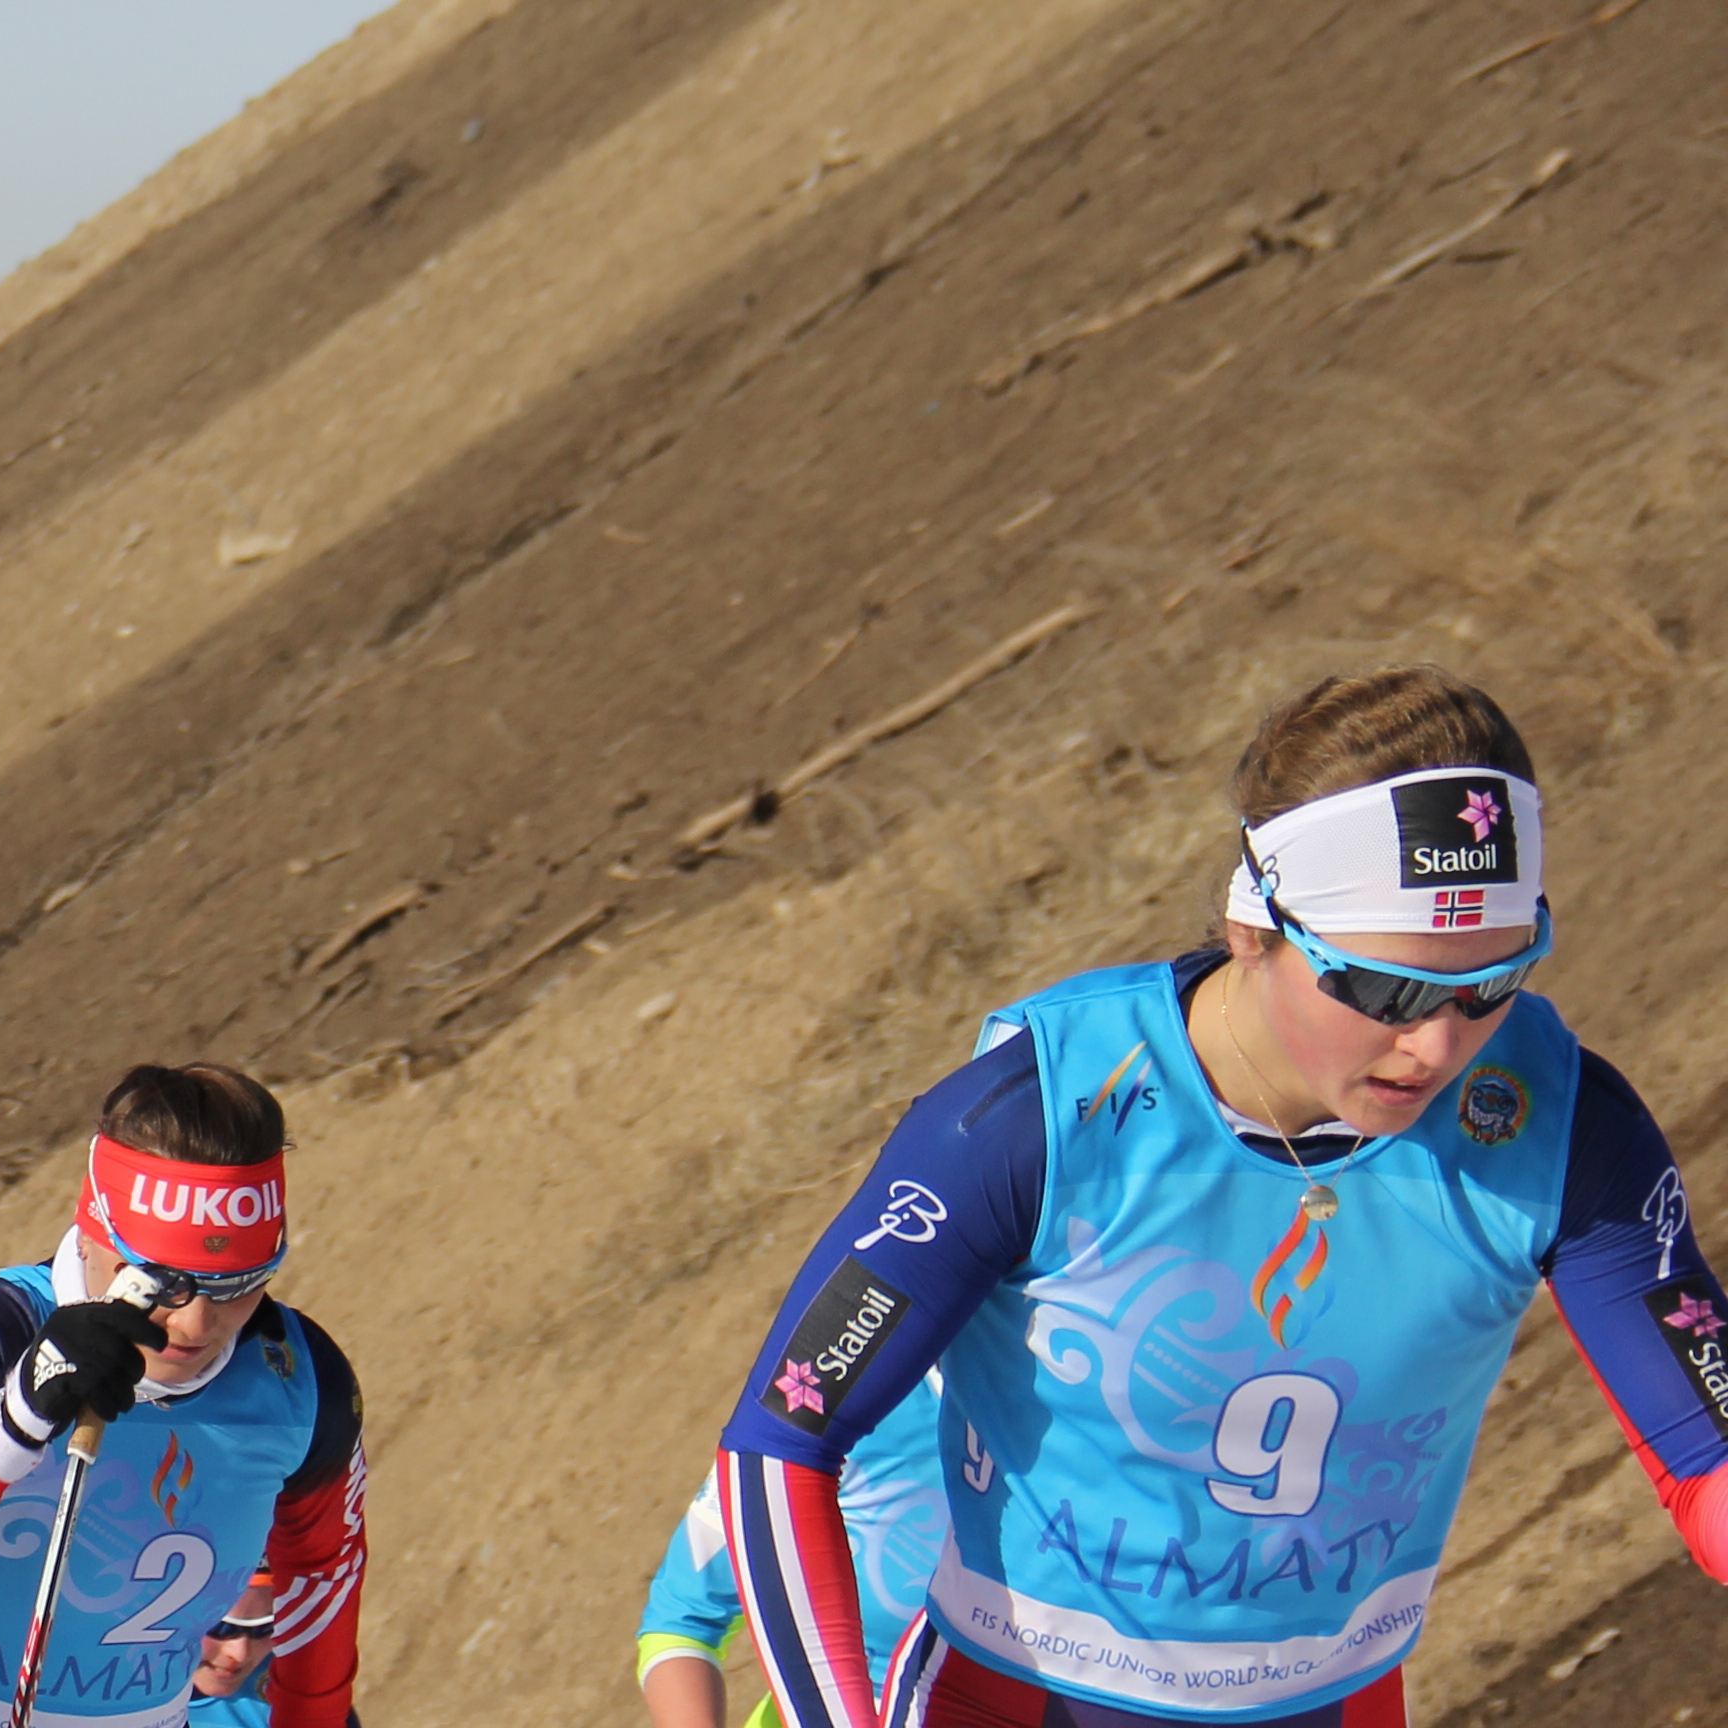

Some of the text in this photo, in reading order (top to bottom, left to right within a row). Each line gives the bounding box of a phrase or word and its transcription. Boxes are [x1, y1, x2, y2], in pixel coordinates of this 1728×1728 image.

[1412, 841, 1497, 876] Statoil
[128, 1173, 282, 1227] LUKOIL
[815, 1286, 897, 1384] Statoil
[1205, 1370, 1342, 1516] 9
[99, 1532, 216, 1646] 2
[1038, 1498, 1411, 1600] ALMATY
[970, 1606, 996, 1630] FIS
[1001, 1619, 1092, 1662] NORDIC
[1094, 1647, 1178, 1688] JUNIOR
[1184, 1665, 1259, 1690] WORLD
[1262, 1662, 1291, 1683] SKI
